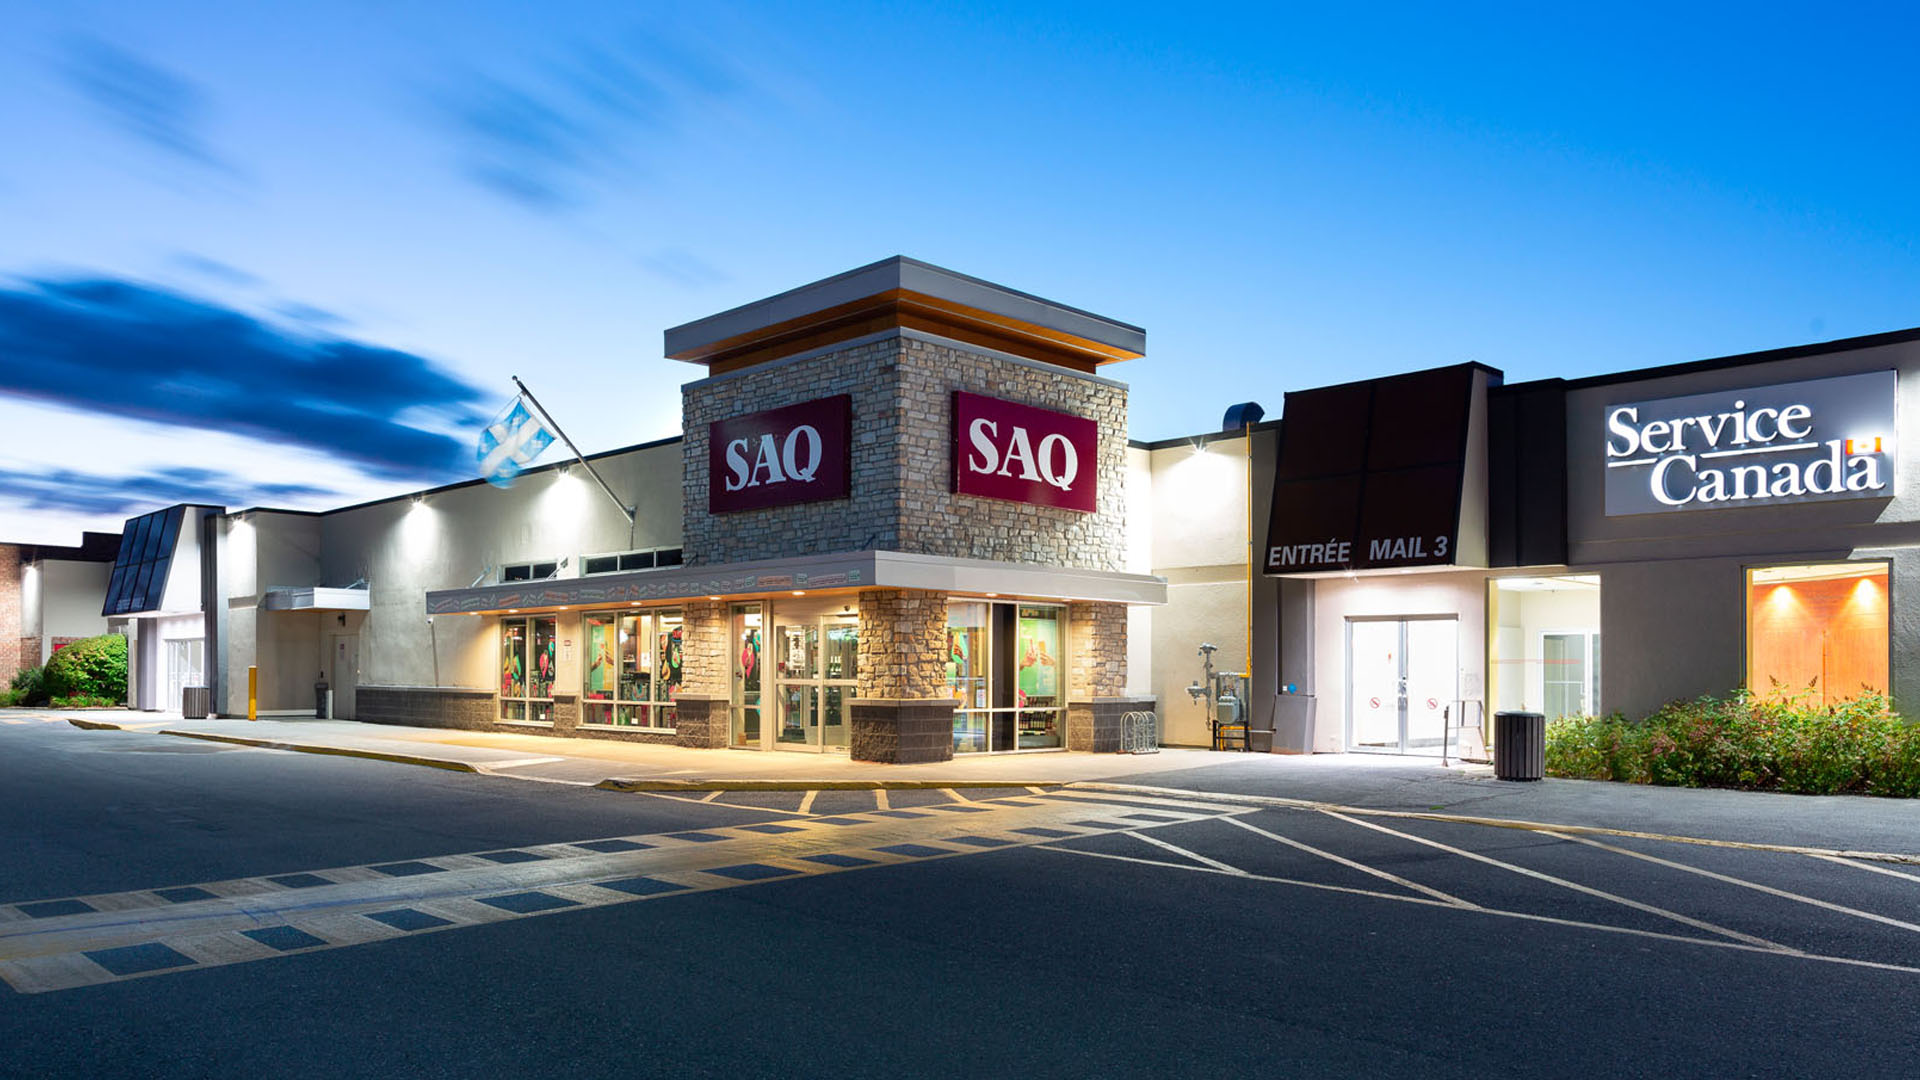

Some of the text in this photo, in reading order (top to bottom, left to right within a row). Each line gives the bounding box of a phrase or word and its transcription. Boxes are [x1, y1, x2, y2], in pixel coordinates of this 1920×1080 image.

[725, 425, 823, 491] SAQ
[969, 418, 1078, 491] SAQ
[1607, 401, 1812, 458] Service
[1650, 440, 1885, 505] Canada
[1268, 535, 1448, 566] ENTRÉE MAIL 3
